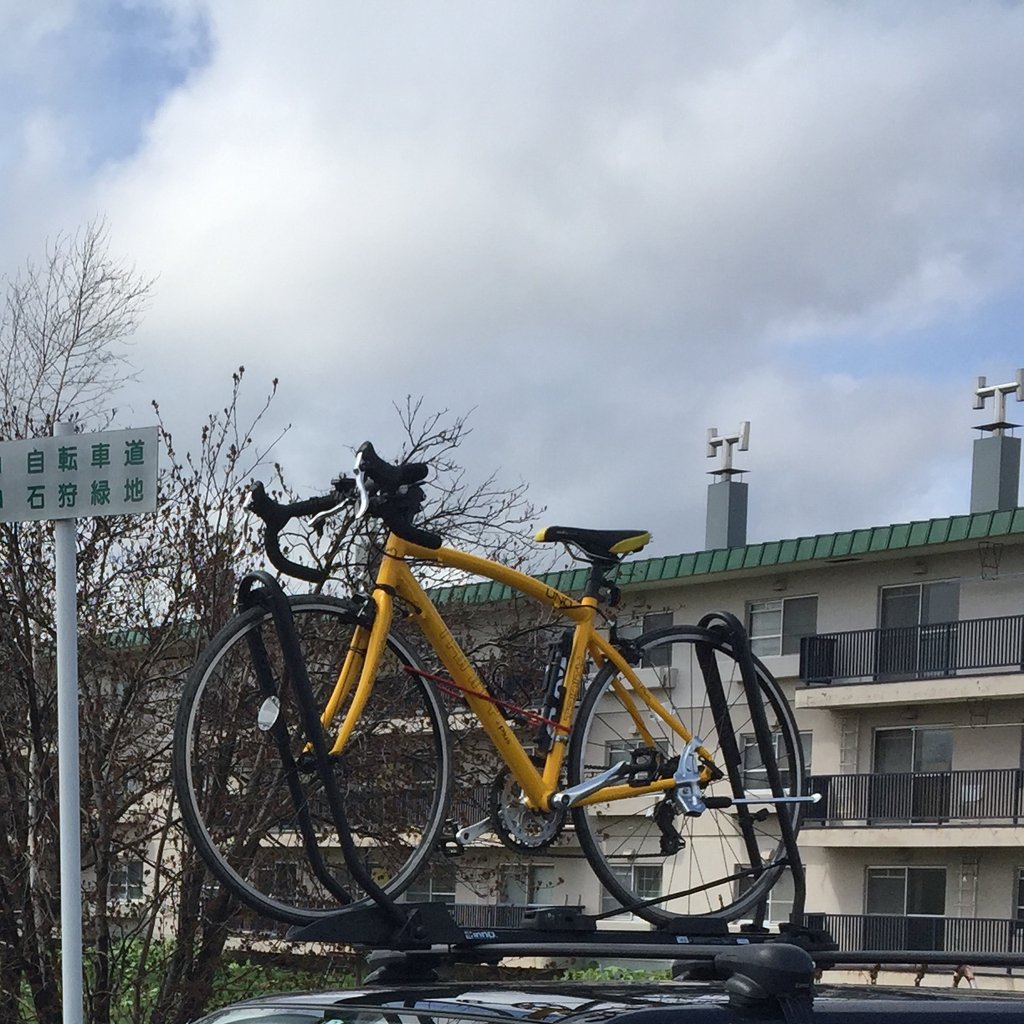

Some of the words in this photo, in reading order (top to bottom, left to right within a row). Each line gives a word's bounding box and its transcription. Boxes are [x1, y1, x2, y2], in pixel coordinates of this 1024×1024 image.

[27, 439, 145, 474] 自転車道
[27, 477, 144, 510] 石狩緑地
